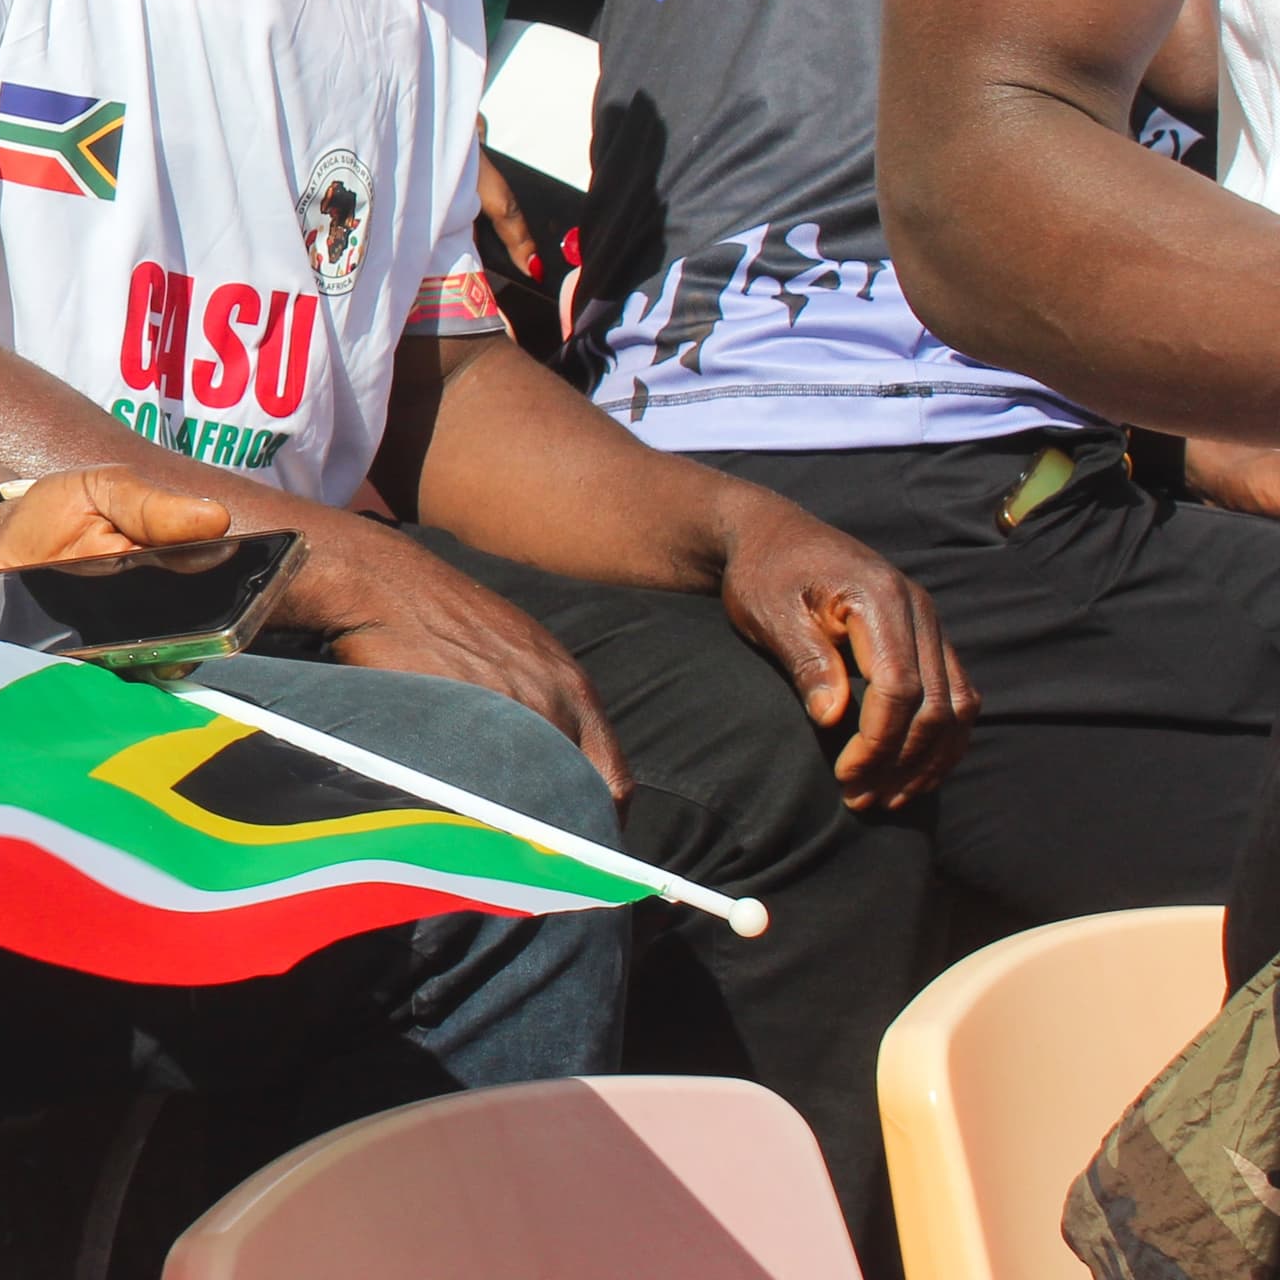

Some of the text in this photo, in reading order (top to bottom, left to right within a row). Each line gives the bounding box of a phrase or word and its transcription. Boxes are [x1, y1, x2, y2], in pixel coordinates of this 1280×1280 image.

[298, 179, 318, 215] GREAT
[316, 155, 339, 179] AFRICA
[120, 261, 319, 418] GASU
